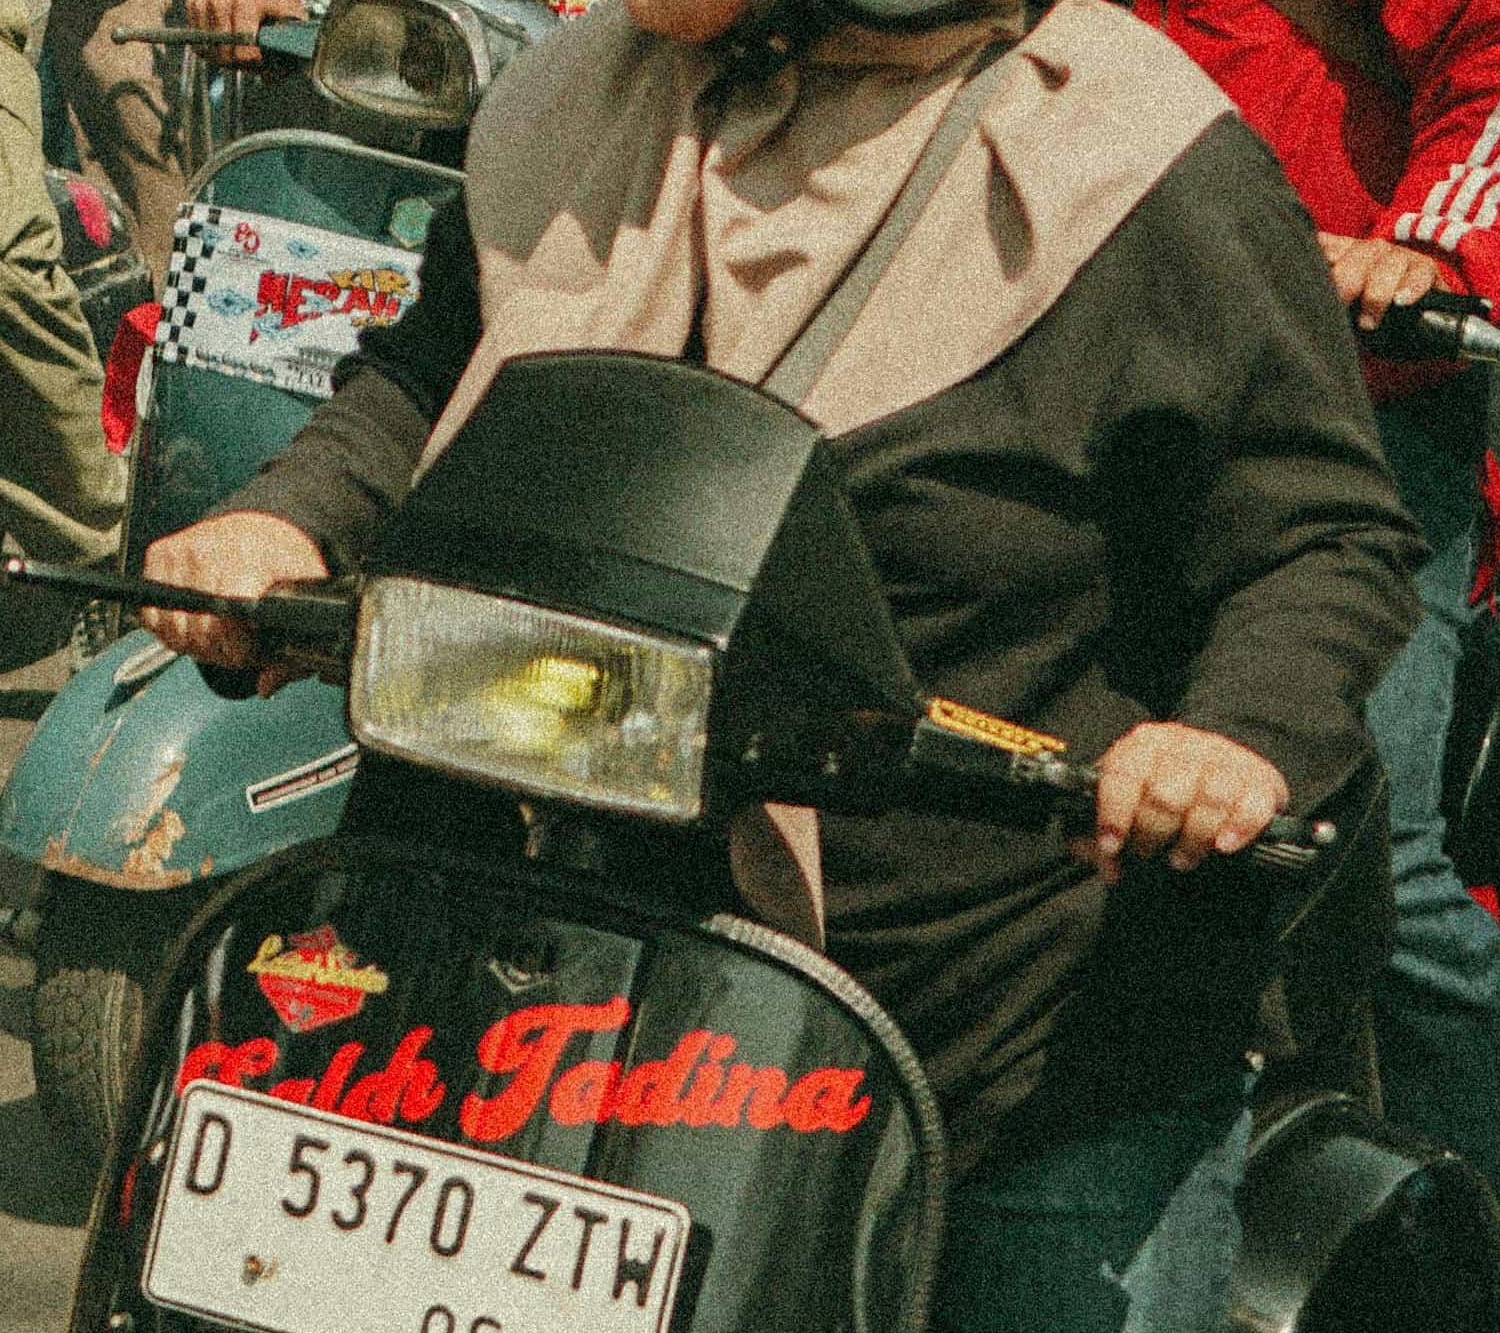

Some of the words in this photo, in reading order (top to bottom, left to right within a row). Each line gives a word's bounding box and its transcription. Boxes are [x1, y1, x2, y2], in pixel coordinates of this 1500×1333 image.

[460, 994, 872, 1143] Tadina
[184, 1111, 233, 1199] D
[280, 1135, 476, 1258] 5370
[510, 1192, 668, 1309] ZTW
